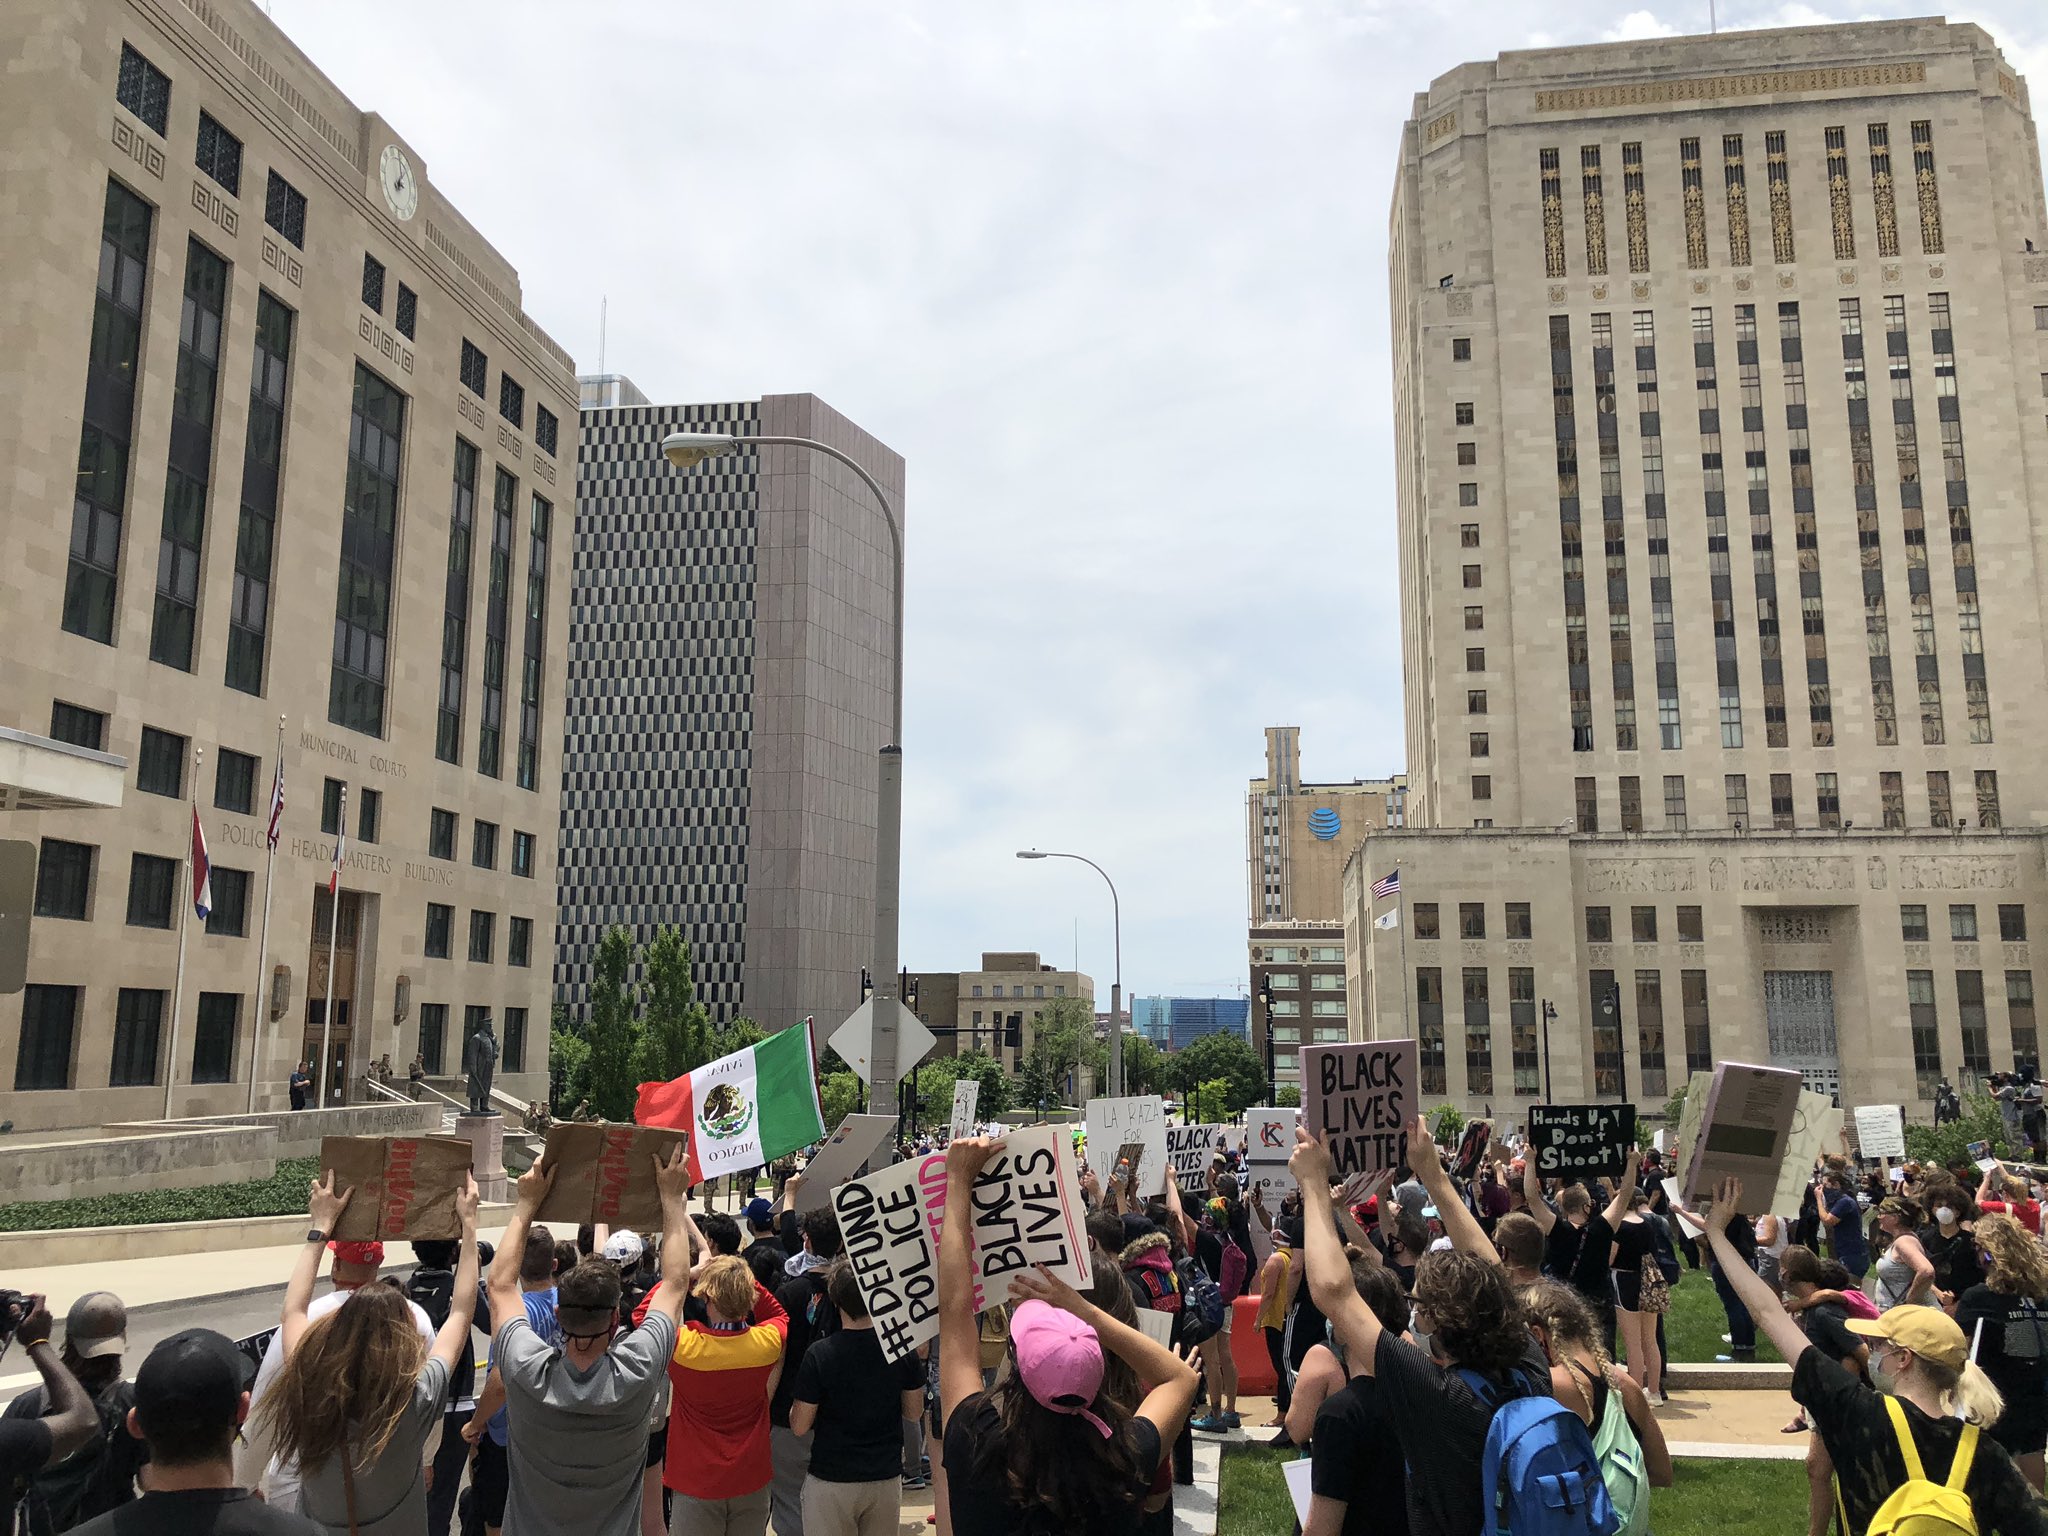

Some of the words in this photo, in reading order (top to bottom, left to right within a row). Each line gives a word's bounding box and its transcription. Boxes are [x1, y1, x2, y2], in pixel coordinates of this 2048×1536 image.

[299, 731, 359, 765] MUNICIPAL
[369, 754, 408, 779] COURTS
[222, 823, 266, 849] POLIC
[405, 862, 454, 886] BUILDING
[1321, 1051, 1404, 1096] BLACK
[1103, 1105, 1118, 1129] LA
[1127, 1101, 1159, 1126] RAZA
[1322, 1091, 1403, 1135] LIVES
[1532, 1109, 1580, 1126] Hands
[1124, 1128, 1142, 1143] FOR
[1166, 1127, 1213, 1152] BLACK
[1539, 1143, 1623, 1169] Shoot!
[1551, 1128, 1606, 1145] Don't
[1176, 1170, 1206, 1190] TTER
[971, 1155, 1028, 1278] BLACK
[1013, 1148, 1069, 1269] LIVES
[835, 1182, 915, 1361] #DEFUND
[876, 1183, 939, 1325] POLICE
